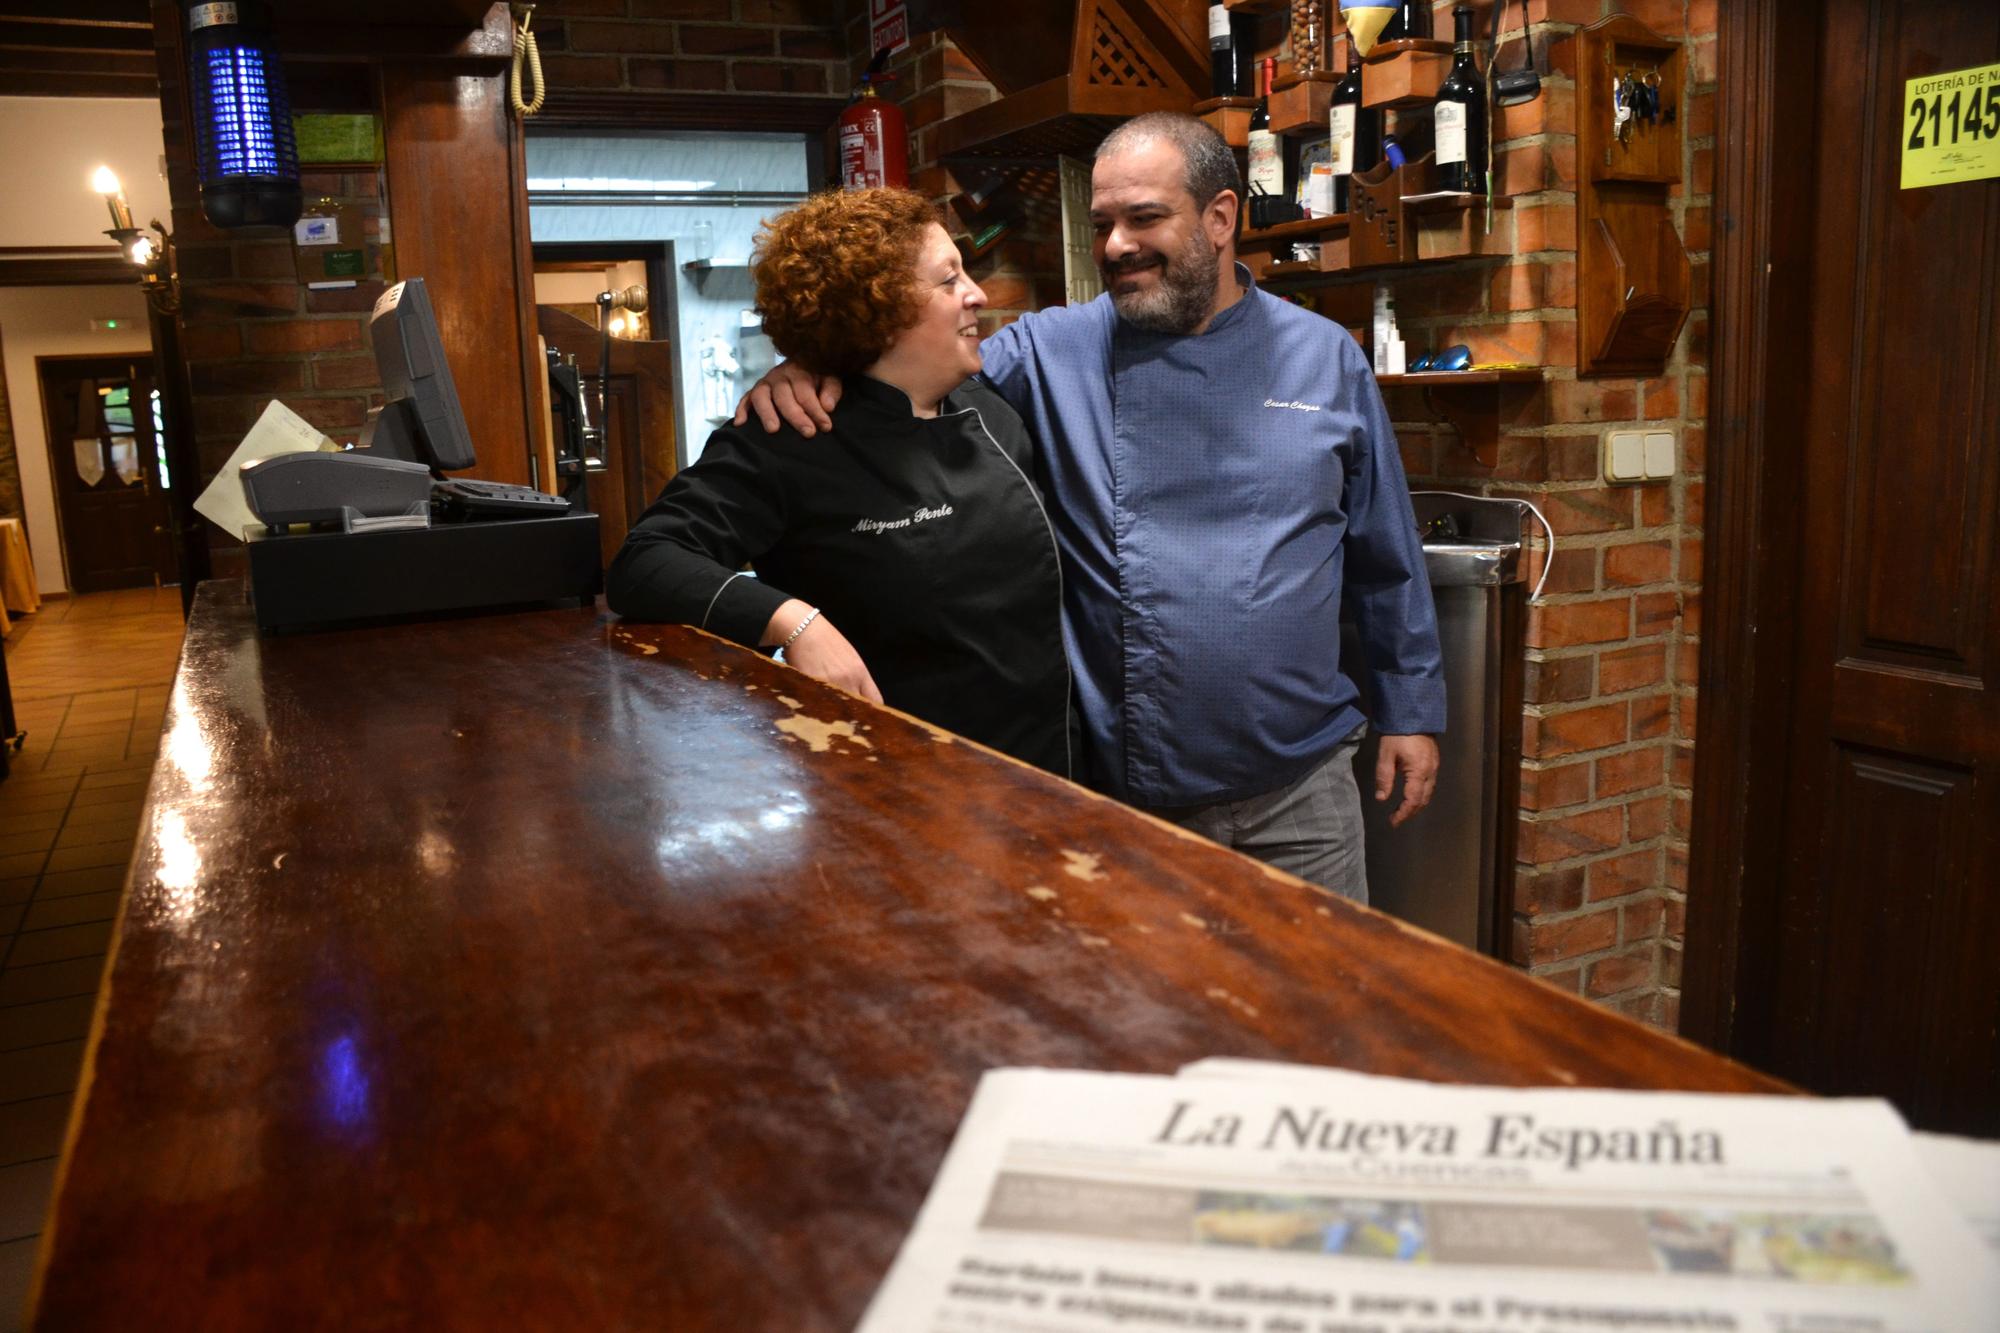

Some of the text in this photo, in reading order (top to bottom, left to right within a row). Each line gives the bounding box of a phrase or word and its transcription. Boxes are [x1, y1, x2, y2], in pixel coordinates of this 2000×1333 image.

[1915, 74, 1964, 95] LOTERÍA
[1968, 72, 1985, 86] DE
[1908, 84, 2000, 150] 21145
[851, 517, 911, 535] Miryam
[1149, 1099, 1726, 1170] La Nueva España
